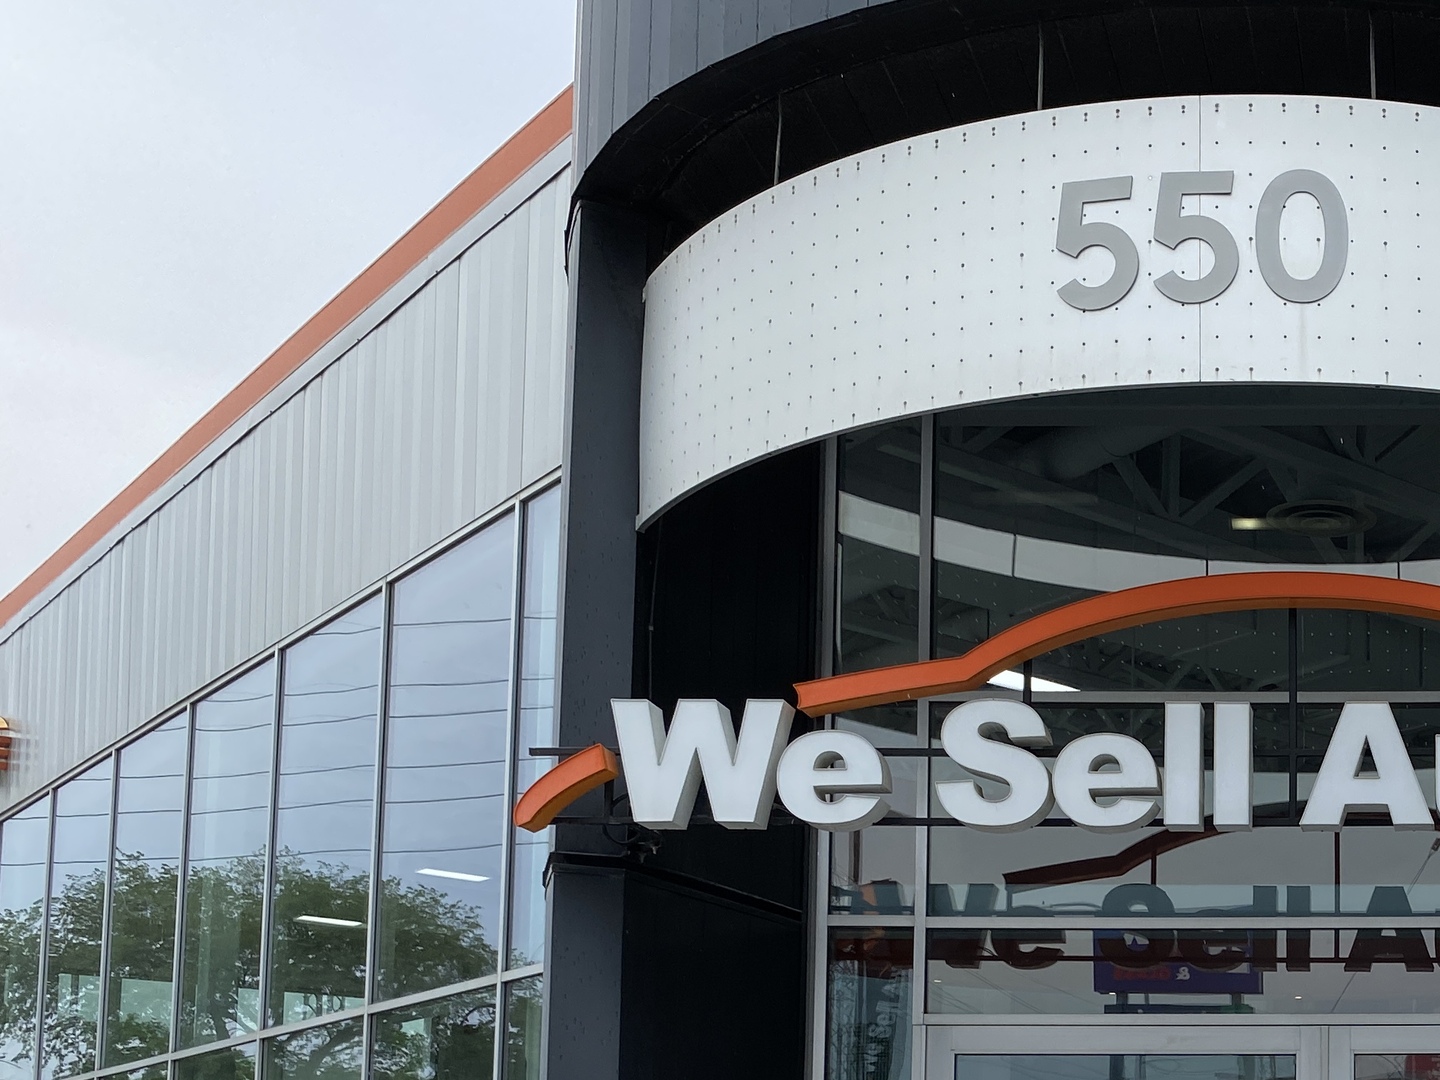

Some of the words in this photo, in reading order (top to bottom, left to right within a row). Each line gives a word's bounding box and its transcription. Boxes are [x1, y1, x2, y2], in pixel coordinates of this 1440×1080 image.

[1056, 168, 1349, 311] 550
[611, 698, 892, 832] We
[935, 698, 1254, 834] Sell
